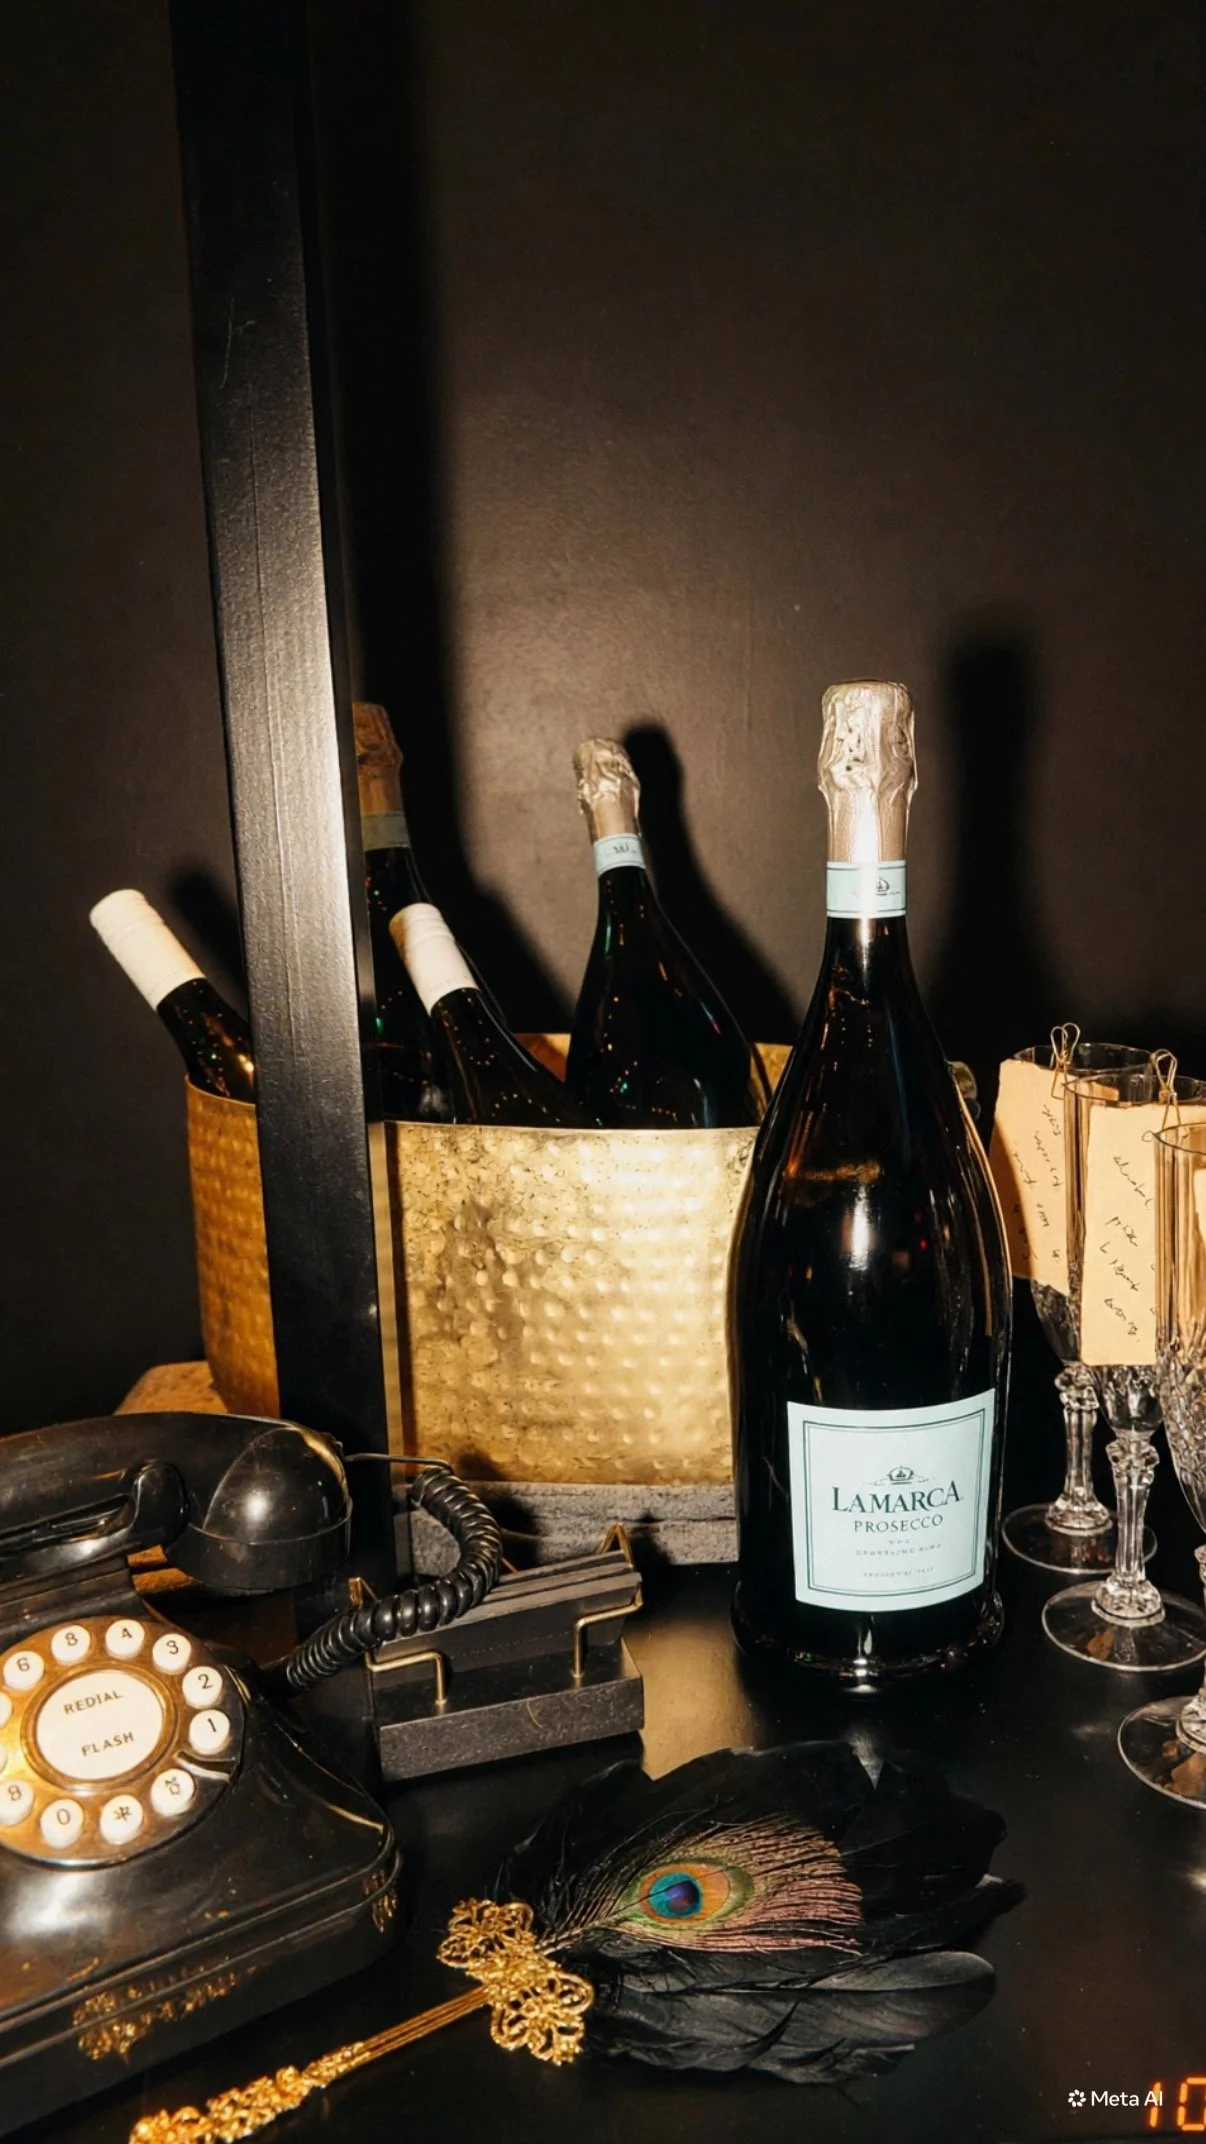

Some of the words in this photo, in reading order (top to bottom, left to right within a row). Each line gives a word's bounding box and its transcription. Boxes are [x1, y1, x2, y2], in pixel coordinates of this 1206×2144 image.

[854, 1514, 944, 1533] PROSECCO
[120, 1627, 133, 1640] 4
[166, 1640, 180, 1655] 3
[16, 1656, 31, 1673] 6
[197, 1673, 213, 1690] 2
[63, 1689, 123, 1715] REDIAL
[207, 1717, 218, 1734] 1
[80, 1731, 135, 1757] FLASH
[56, 1808, 71, 1826] 0
